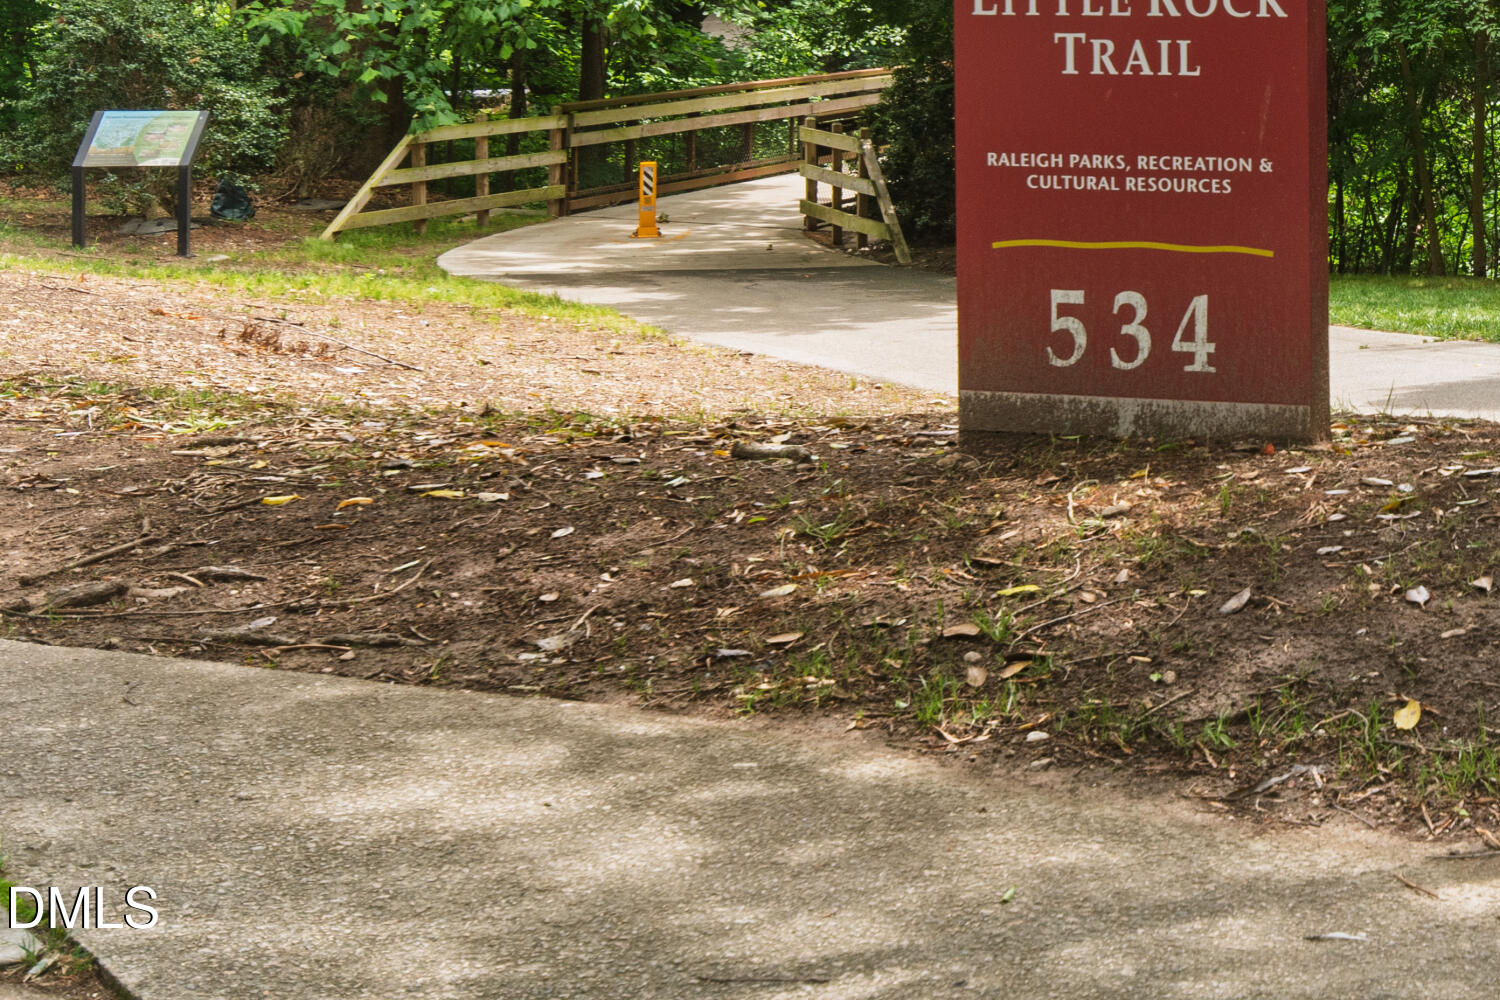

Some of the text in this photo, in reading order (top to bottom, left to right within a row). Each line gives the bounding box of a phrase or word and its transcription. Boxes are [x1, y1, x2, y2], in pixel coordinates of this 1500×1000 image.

[1054, 32, 1201, 76] TRAIL
[986, 152, 1273, 173] RALEIGH PARKS, RECREATION &
[1026, 174, 1232, 194] CULTURAL RESOURCES
[1046, 289, 1217, 373] 534
